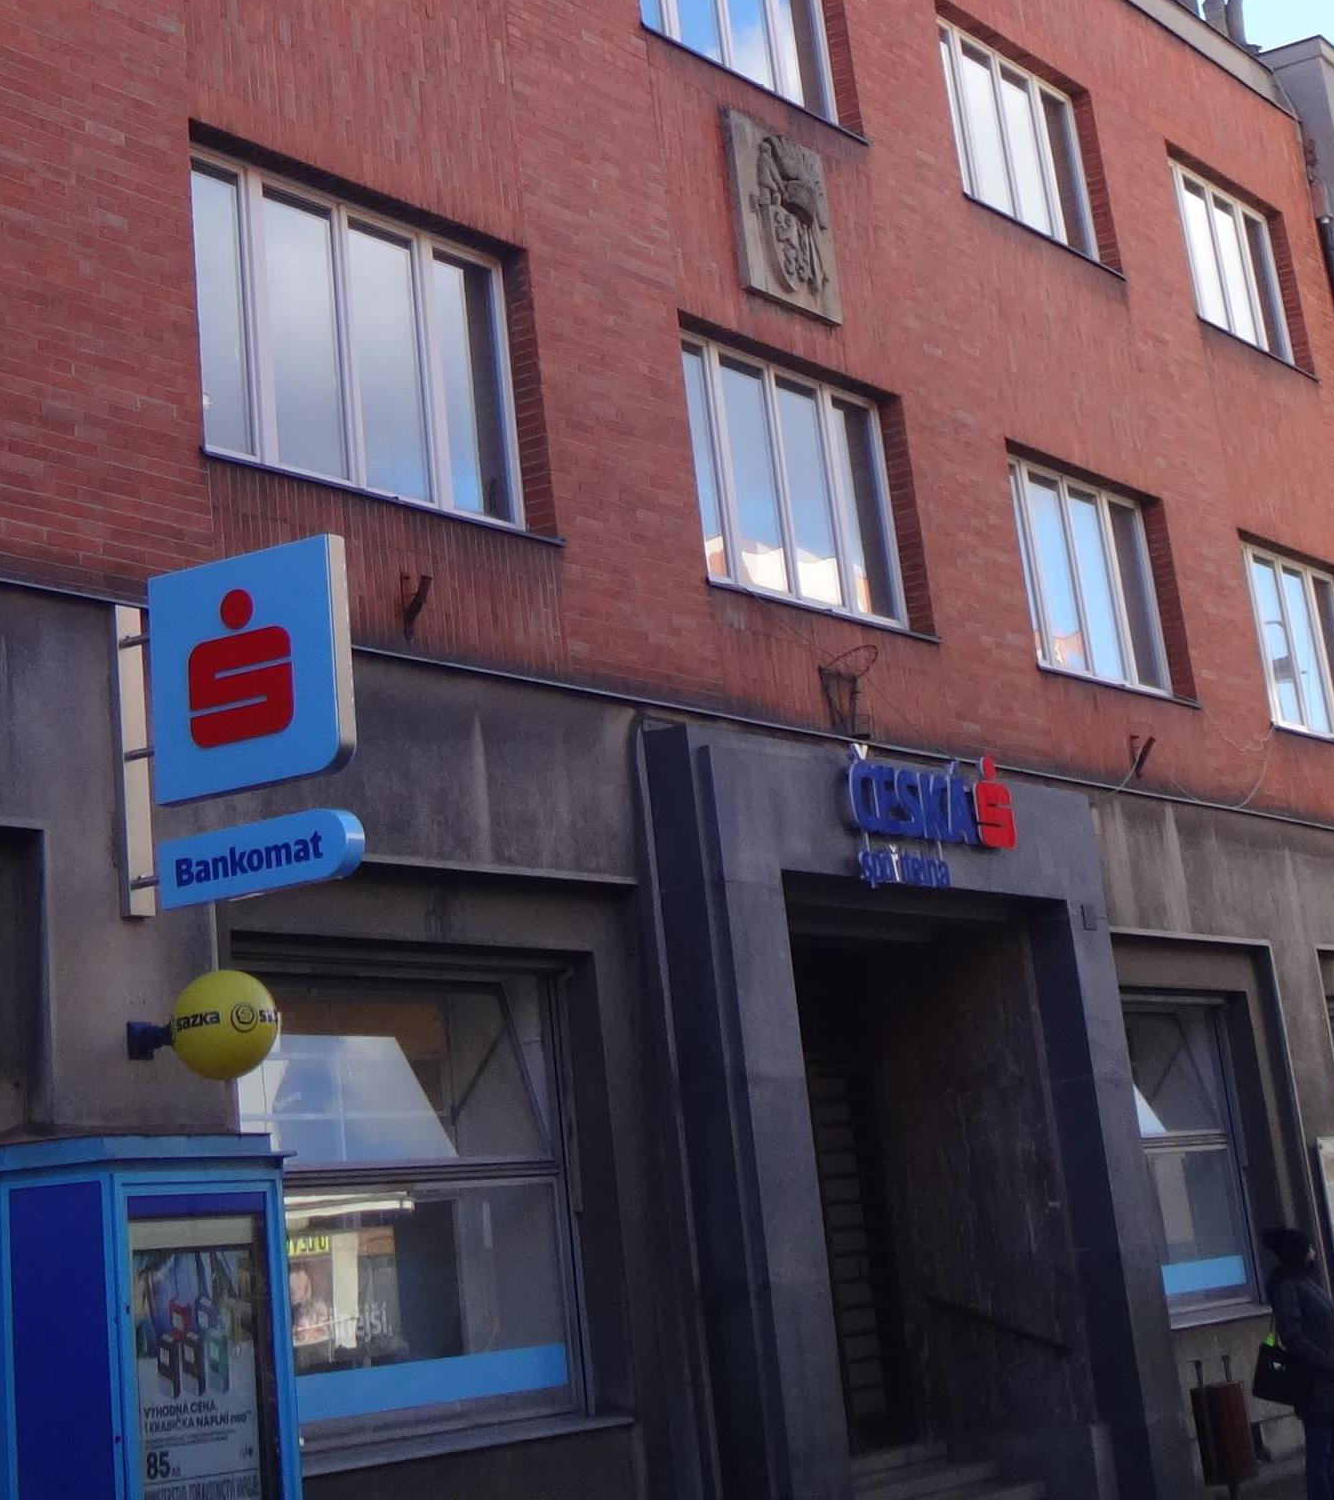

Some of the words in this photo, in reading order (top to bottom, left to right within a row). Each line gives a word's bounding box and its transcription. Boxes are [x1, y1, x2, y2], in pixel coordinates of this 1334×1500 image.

[175, 831, 324, 888] Bankomat
[190, 1400, 218, 1414] CENA
[147, 1450, 171, 1480] 85
